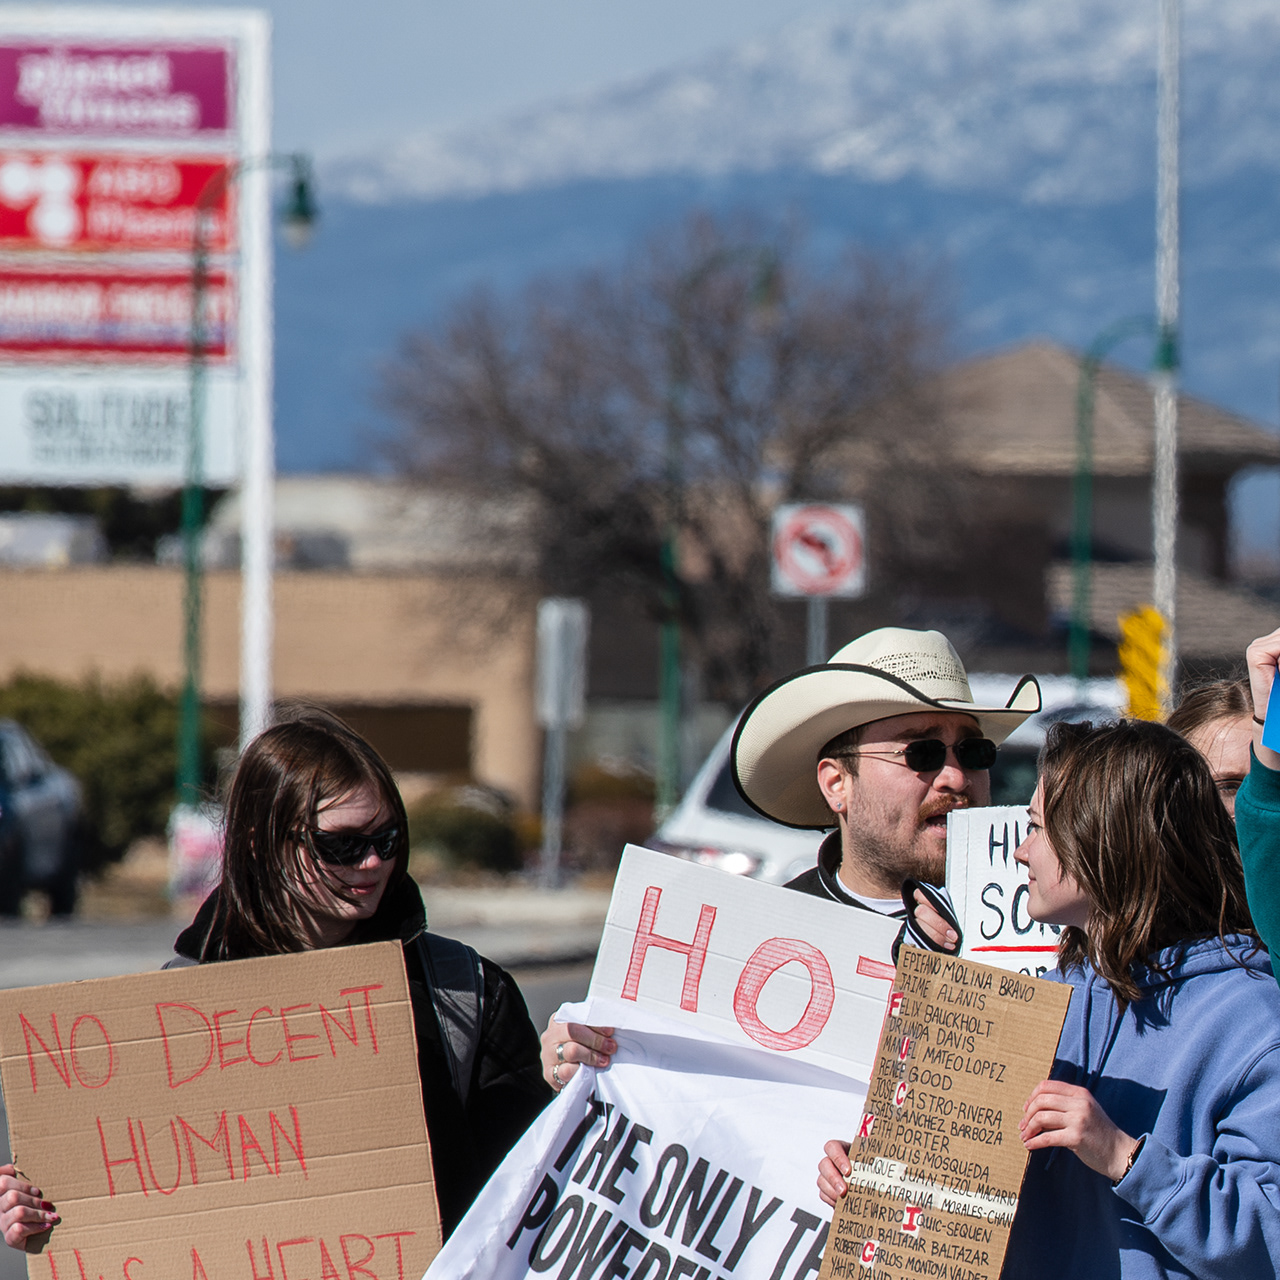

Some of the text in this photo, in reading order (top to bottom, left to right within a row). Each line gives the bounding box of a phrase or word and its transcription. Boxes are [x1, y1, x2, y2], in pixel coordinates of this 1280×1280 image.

[898, 972, 987, 1011] JAIME ALANIS
[902, 950, 942, 976] EPIFANO
[942, 961, 992, 990] MOLINA
[999, 976, 1035, 1002] BRAVO
[19, 984, 384, 1094] NO DECENT
[924, 1004, 994, 1038] BAUCKHOLT
[936, 1030, 975, 1054] DAVIS
[882, 1036, 1007, 1082] MANUEL MATEO LOPEZ
[908, 1065, 953, 1092] GOOD
[859, 1114, 950, 1154] KEITH PORTER
[895, 1107, 946, 1133] SANCHEZ
[950, 1122, 1003, 1146] BARBOZA
[96, 1104, 309, 1199] HUMAN
[858, 1137, 990, 1184] RYAN LOUIS MOSQUEDA
[553, 1090, 655, 1206] THE
[639, 1143, 784, 1273] ONLY
[848, 1177, 1014, 1228] ELENA CATARINA MORALES-CHAN
[852, 1153, 1018, 1206] ENRIQUE JUAN TIZOL MACARIO
[837, 1218, 990, 1266] BARTOLO BALTAZAR BALTAZAR
[862, 1241, 903, 1269] CARLOS
[905, 1256, 950, 1280] MONTOYA
[830, 1256, 855, 1280] YAHIR
